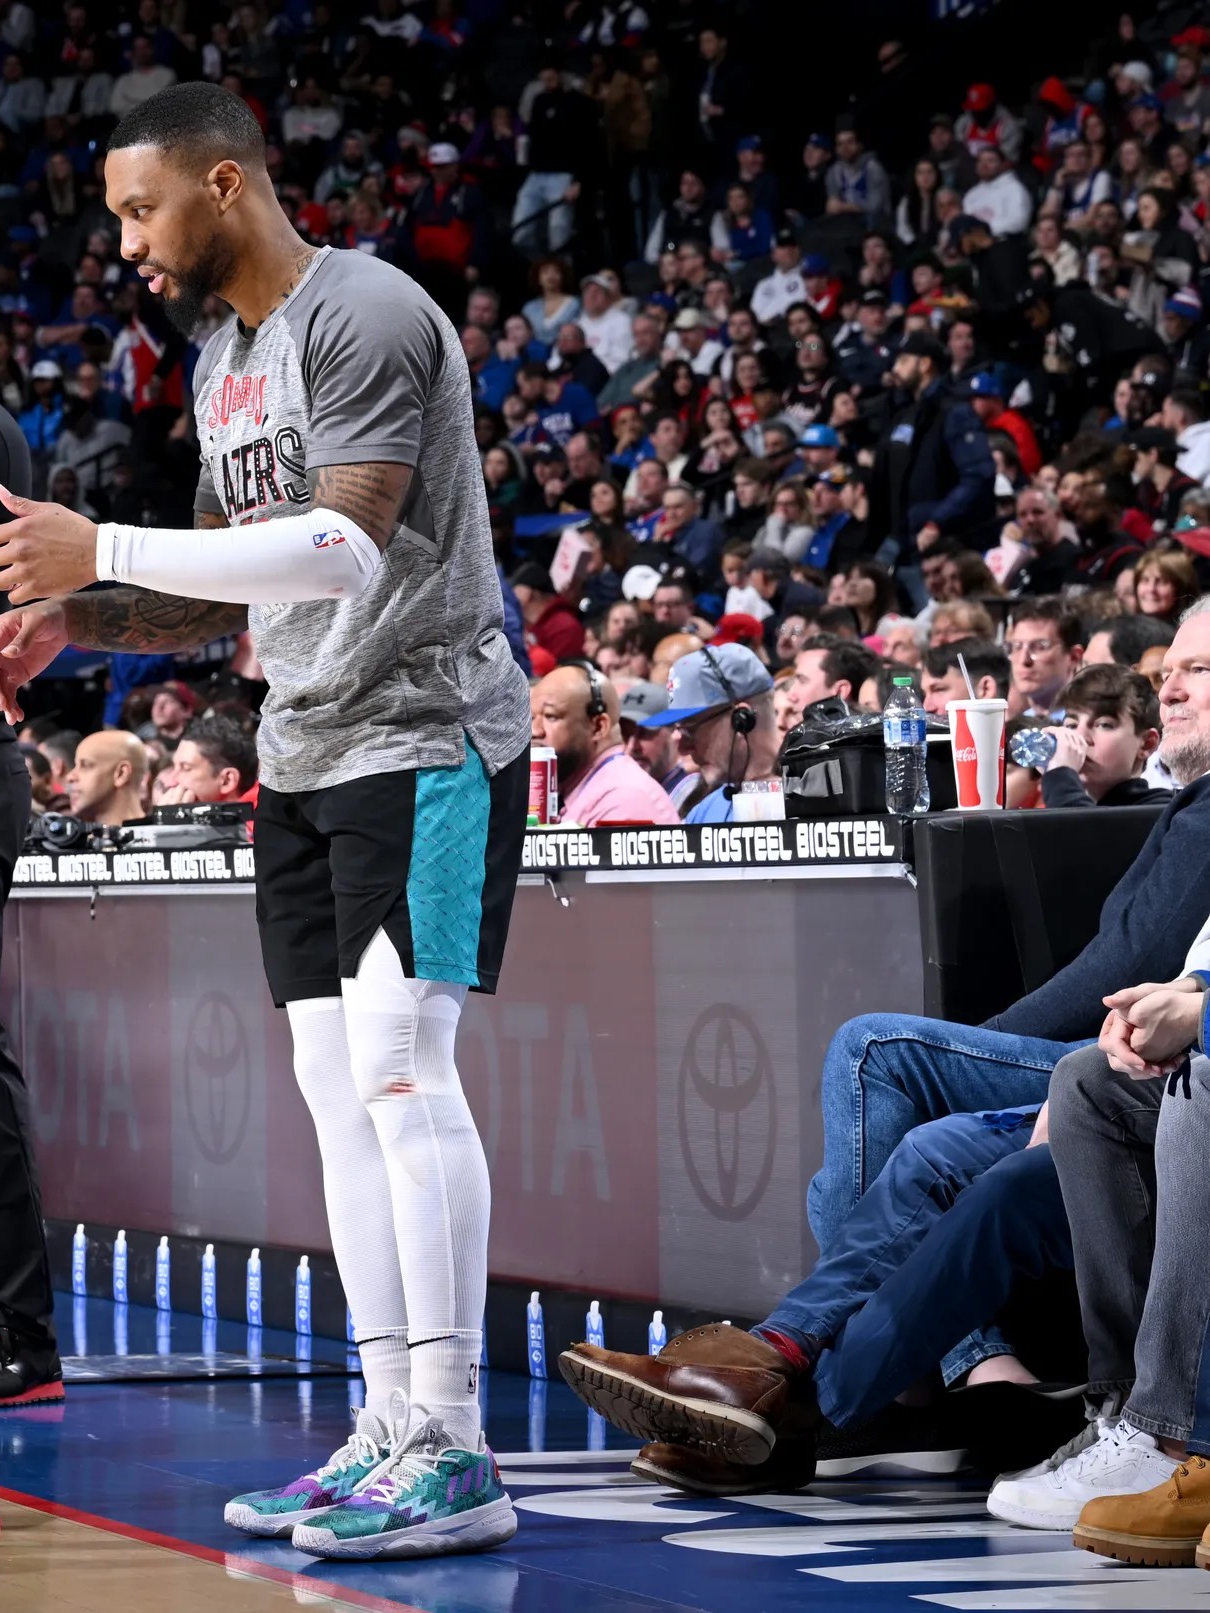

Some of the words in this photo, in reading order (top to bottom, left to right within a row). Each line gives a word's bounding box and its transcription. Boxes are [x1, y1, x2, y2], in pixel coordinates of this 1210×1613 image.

[209, 425, 311, 520] AZERS
[12, 855, 57, 882] OSTEEL
[170, 850, 231, 880] BIOSTEEL
[521, 833, 600, 867] BIOSTEEL
[610, 829, 696, 866] BIOSTEEL
[701, 826, 792, 863] BIOSTEEL
[796, 820, 895, 858] BIOSTEEL
[12, 986, 142, 1152] OTA
